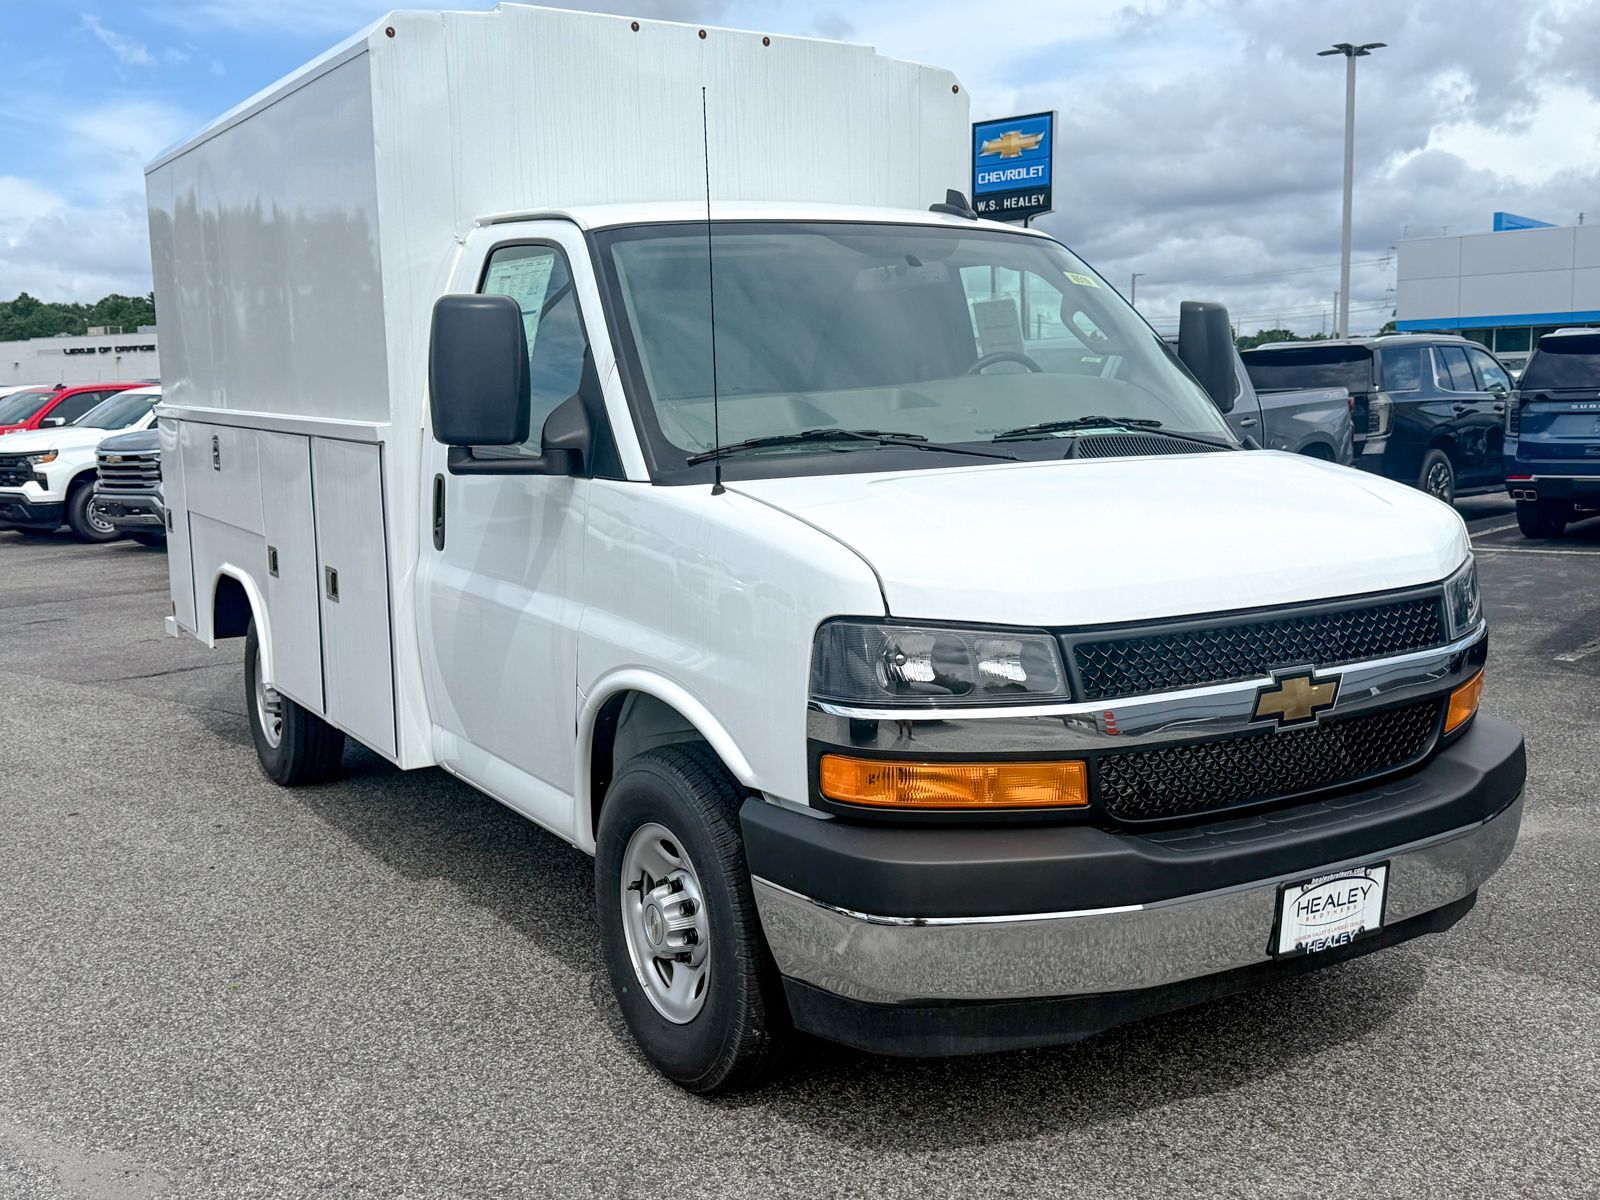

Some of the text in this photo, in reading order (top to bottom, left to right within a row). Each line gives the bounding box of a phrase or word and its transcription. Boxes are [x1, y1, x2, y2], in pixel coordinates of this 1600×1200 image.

[978, 165, 1044, 185] CHEVROLET
[977, 194, 1045, 212] W.S. HEALEY
[63, 344, 156, 355] LEXUS OF ORANGE
[1297, 884, 1372, 917] HEALEY
[1305, 904, 1357, 922] BROTHERS
[1307, 929, 1355, 954] HEALEY
